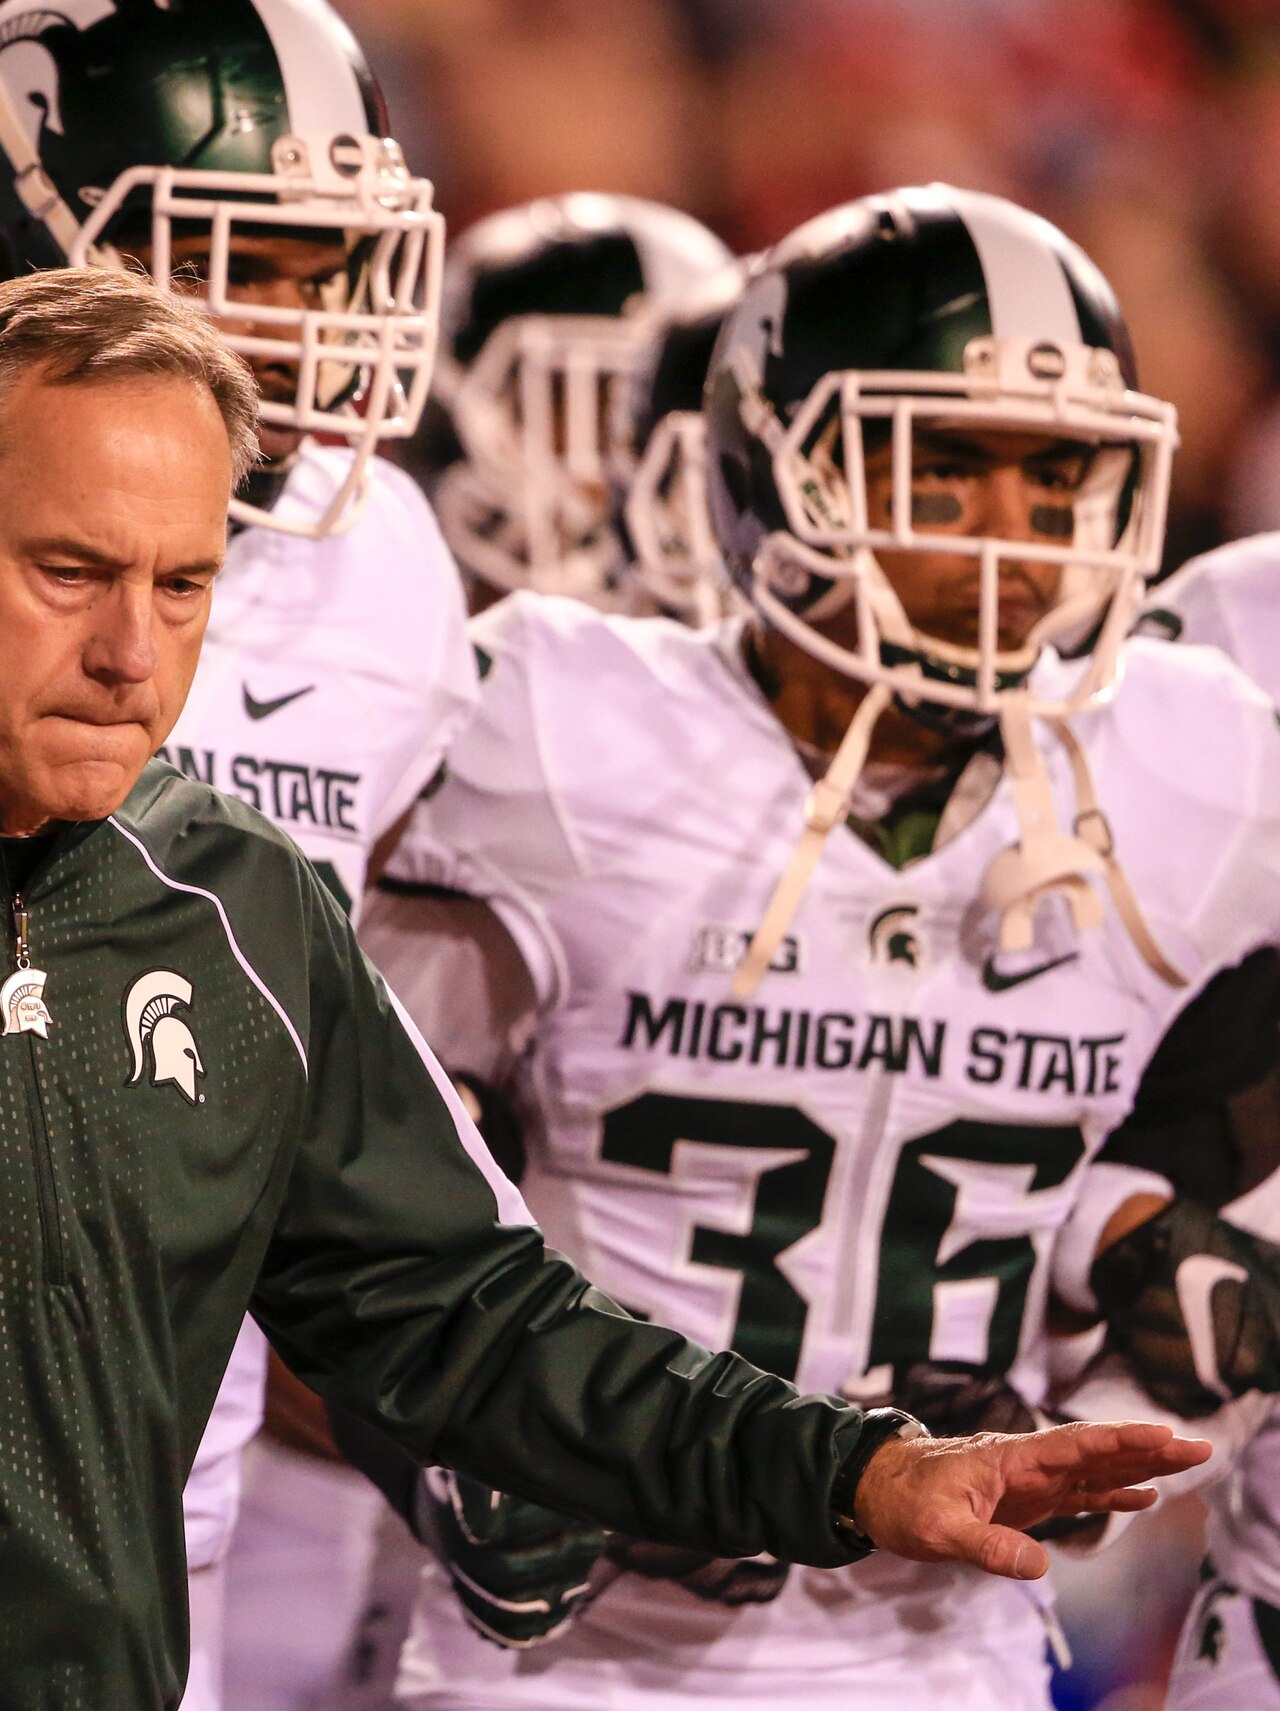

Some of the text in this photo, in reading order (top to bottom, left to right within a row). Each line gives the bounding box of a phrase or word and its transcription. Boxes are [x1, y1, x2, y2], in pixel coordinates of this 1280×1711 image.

[231, 755, 360, 833] STATE
[621, 992, 1126, 1096] MICHIGAN STATE
[601, 1092, 1087, 1386] 36
